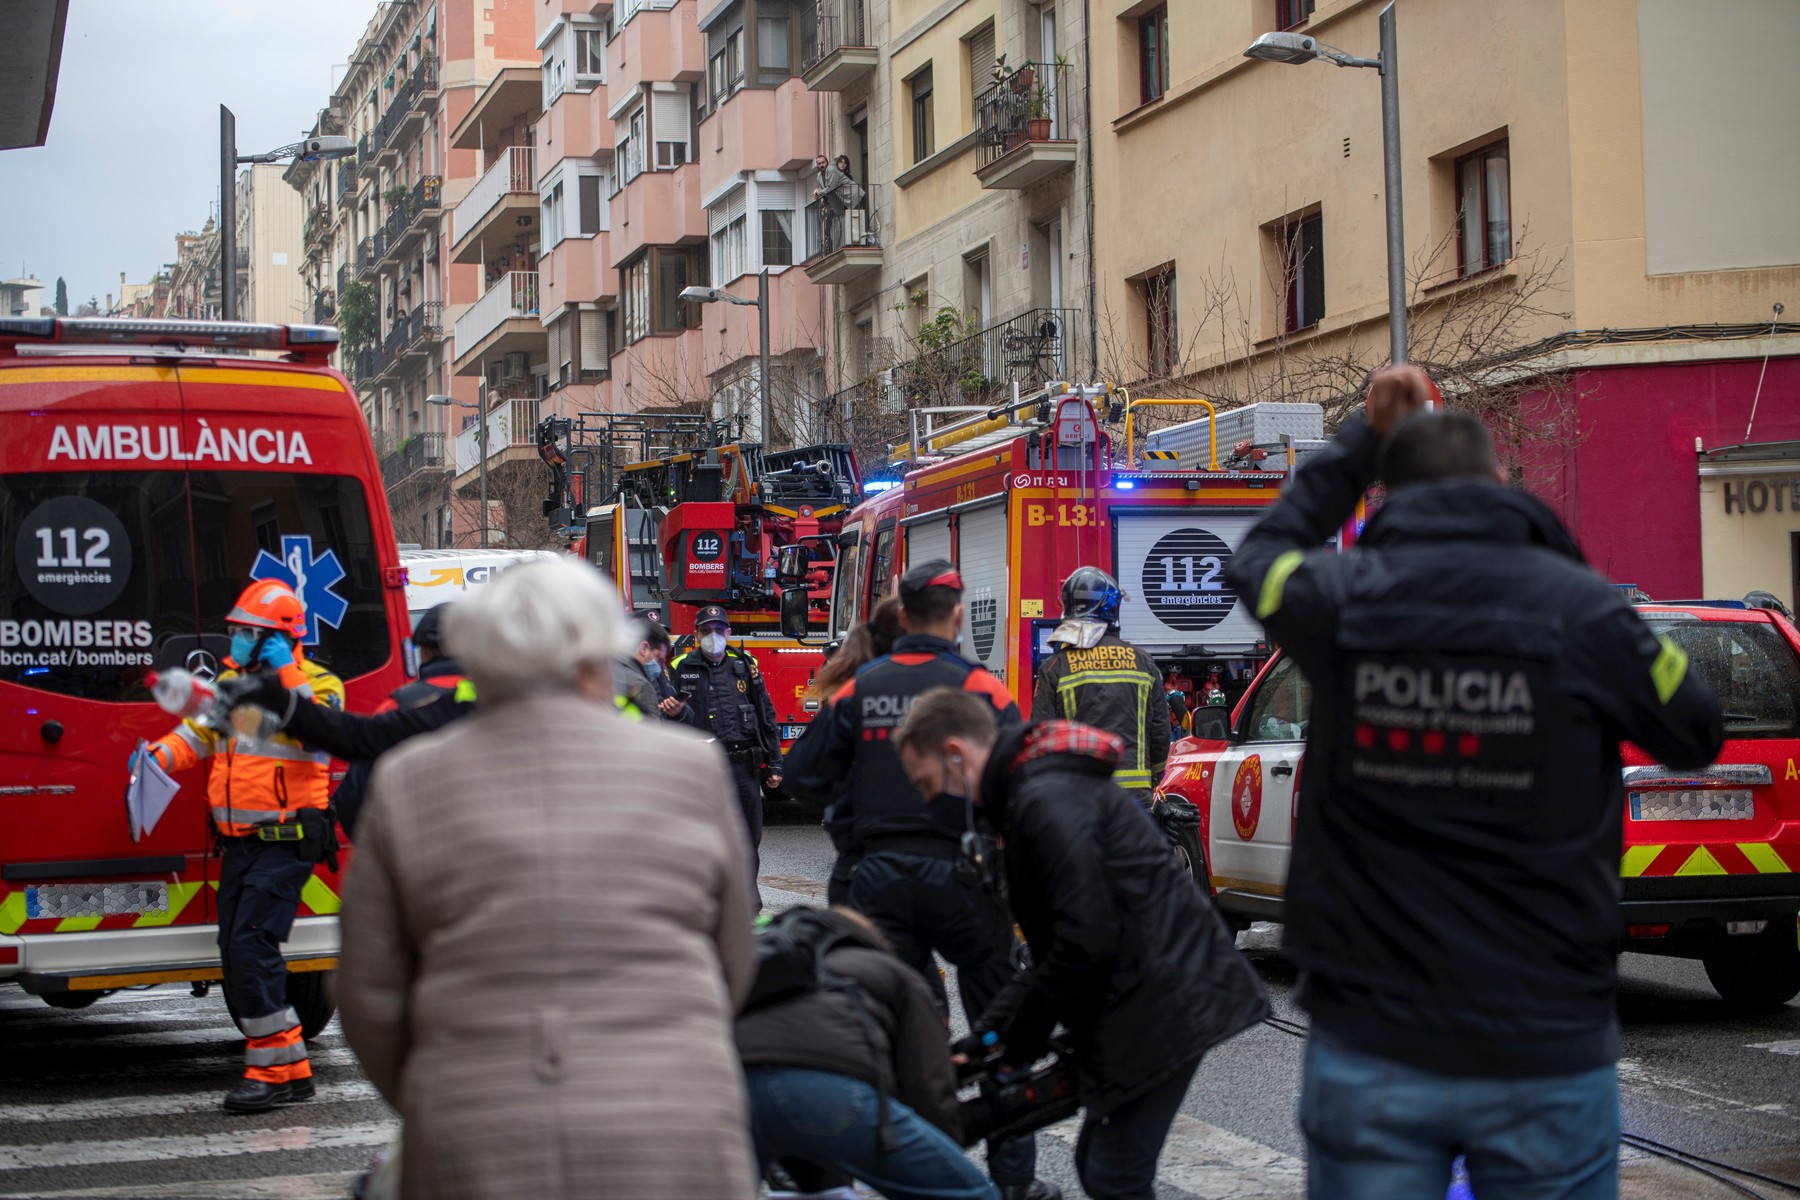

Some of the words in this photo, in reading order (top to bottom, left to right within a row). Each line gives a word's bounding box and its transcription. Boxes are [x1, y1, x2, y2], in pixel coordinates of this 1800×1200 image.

[47, 418, 313, 465] AMBULÀNCIA
[36, 527, 111, 567] 112
[697, 539, 718, 550] 112
[37, 570, 112, 586] emergències
[1160, 556, 1222, 590] 112
[1160, 594, 1223, 606] emergències
[0, 620, 153, 647] BOMBERS
[0, 648, 154, 667] bcn.cat/bombers
[1065, 645, 1137, 664] BOMBERS
[1069, 660, 1138, 674] BARCELONA
[1355, 663, 1533, 712] POLICIA
